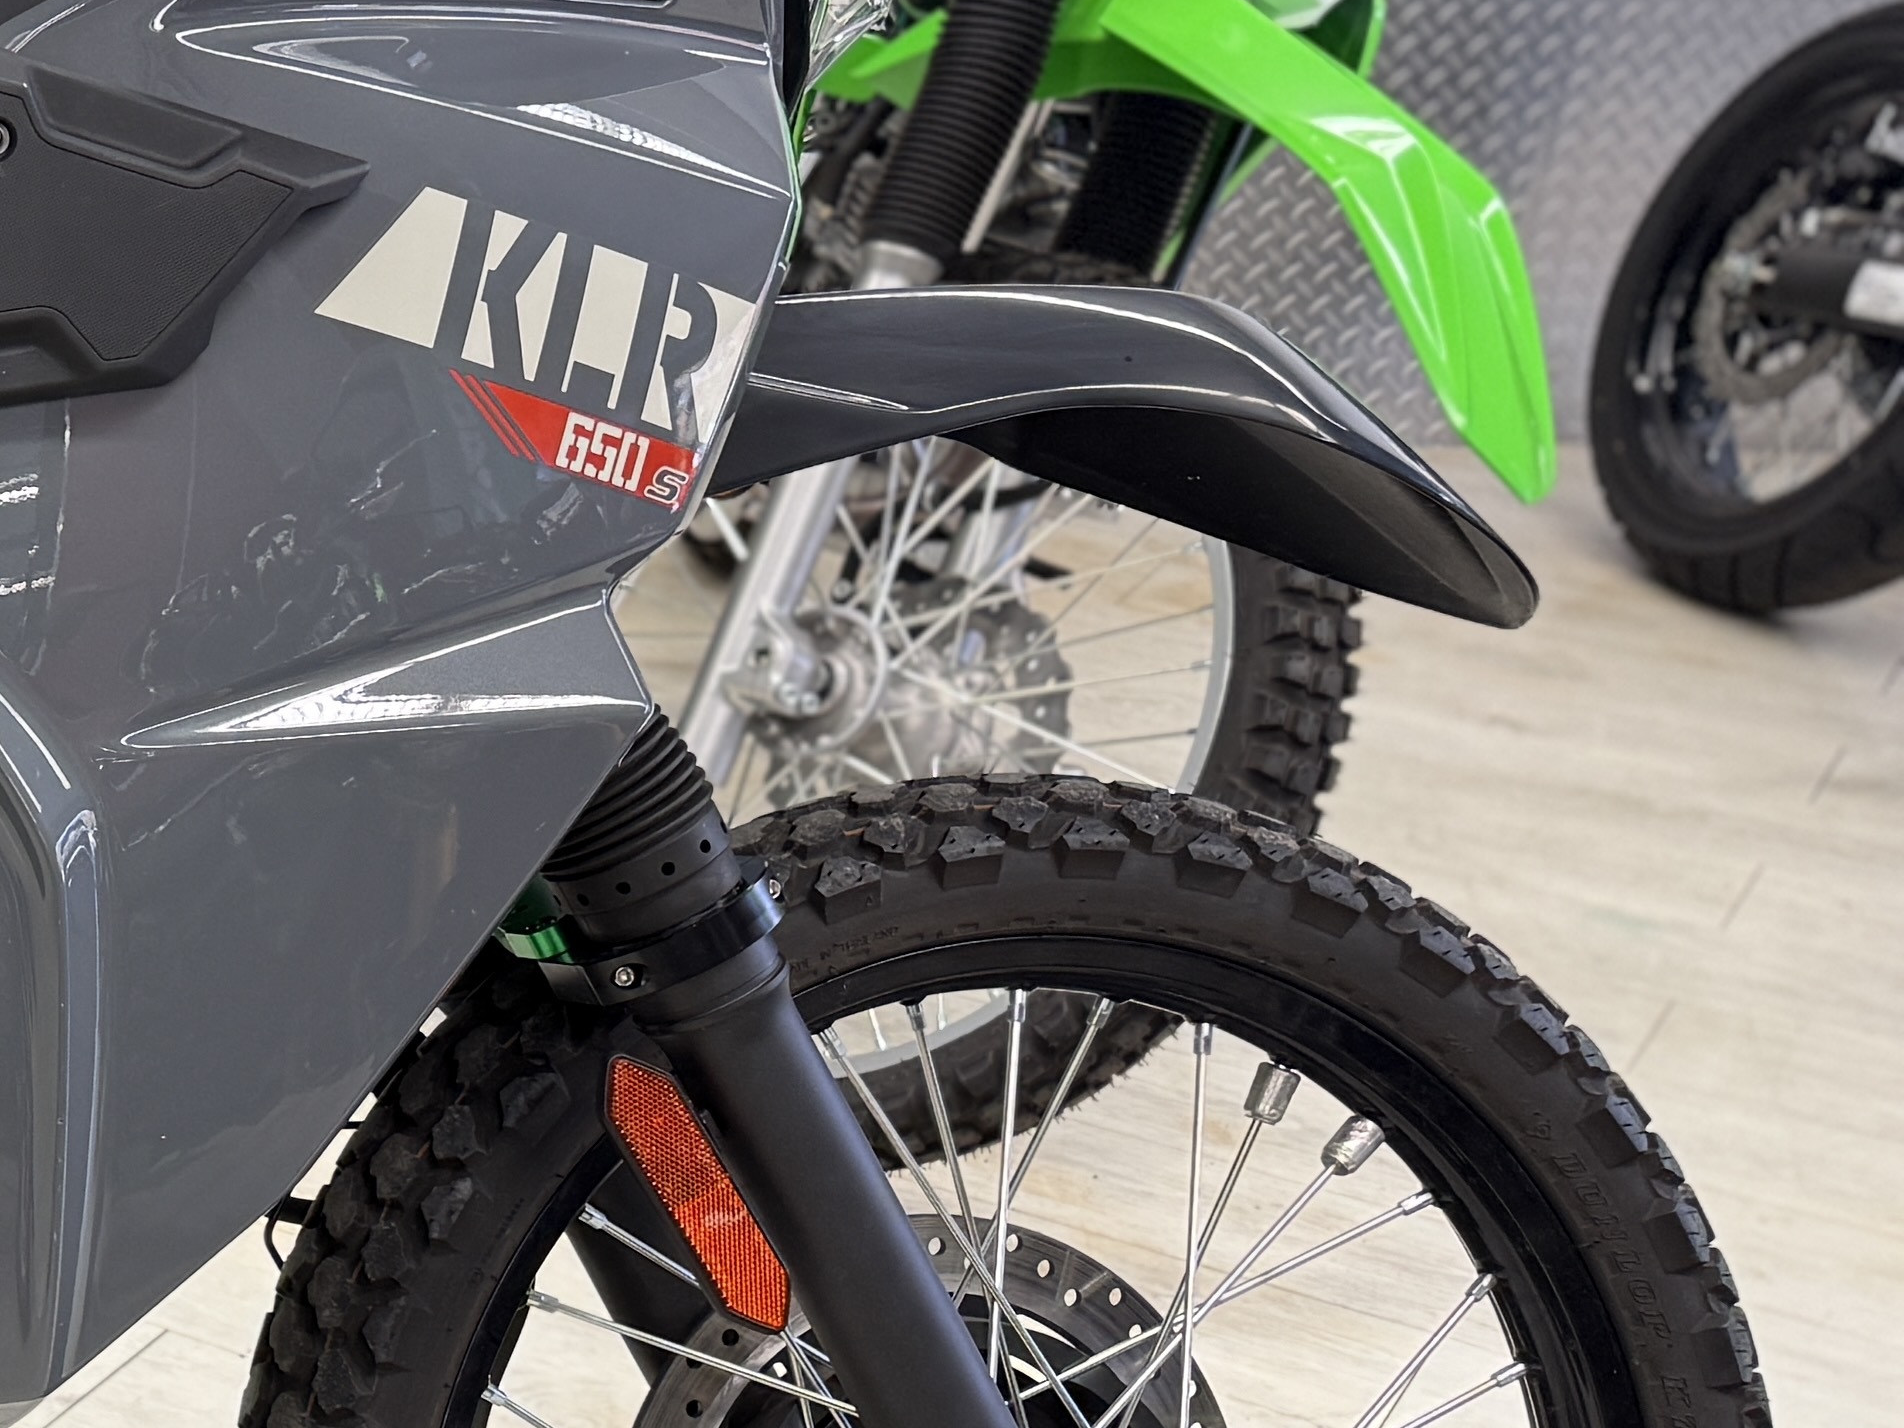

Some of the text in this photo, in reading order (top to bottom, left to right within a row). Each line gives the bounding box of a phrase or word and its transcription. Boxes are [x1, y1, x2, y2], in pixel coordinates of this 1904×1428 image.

[428, 187, 734, 444] KLR
[554, 410, 691, 504] 650 S
[1550, 1149, 1673, 1349] DUNLOP
